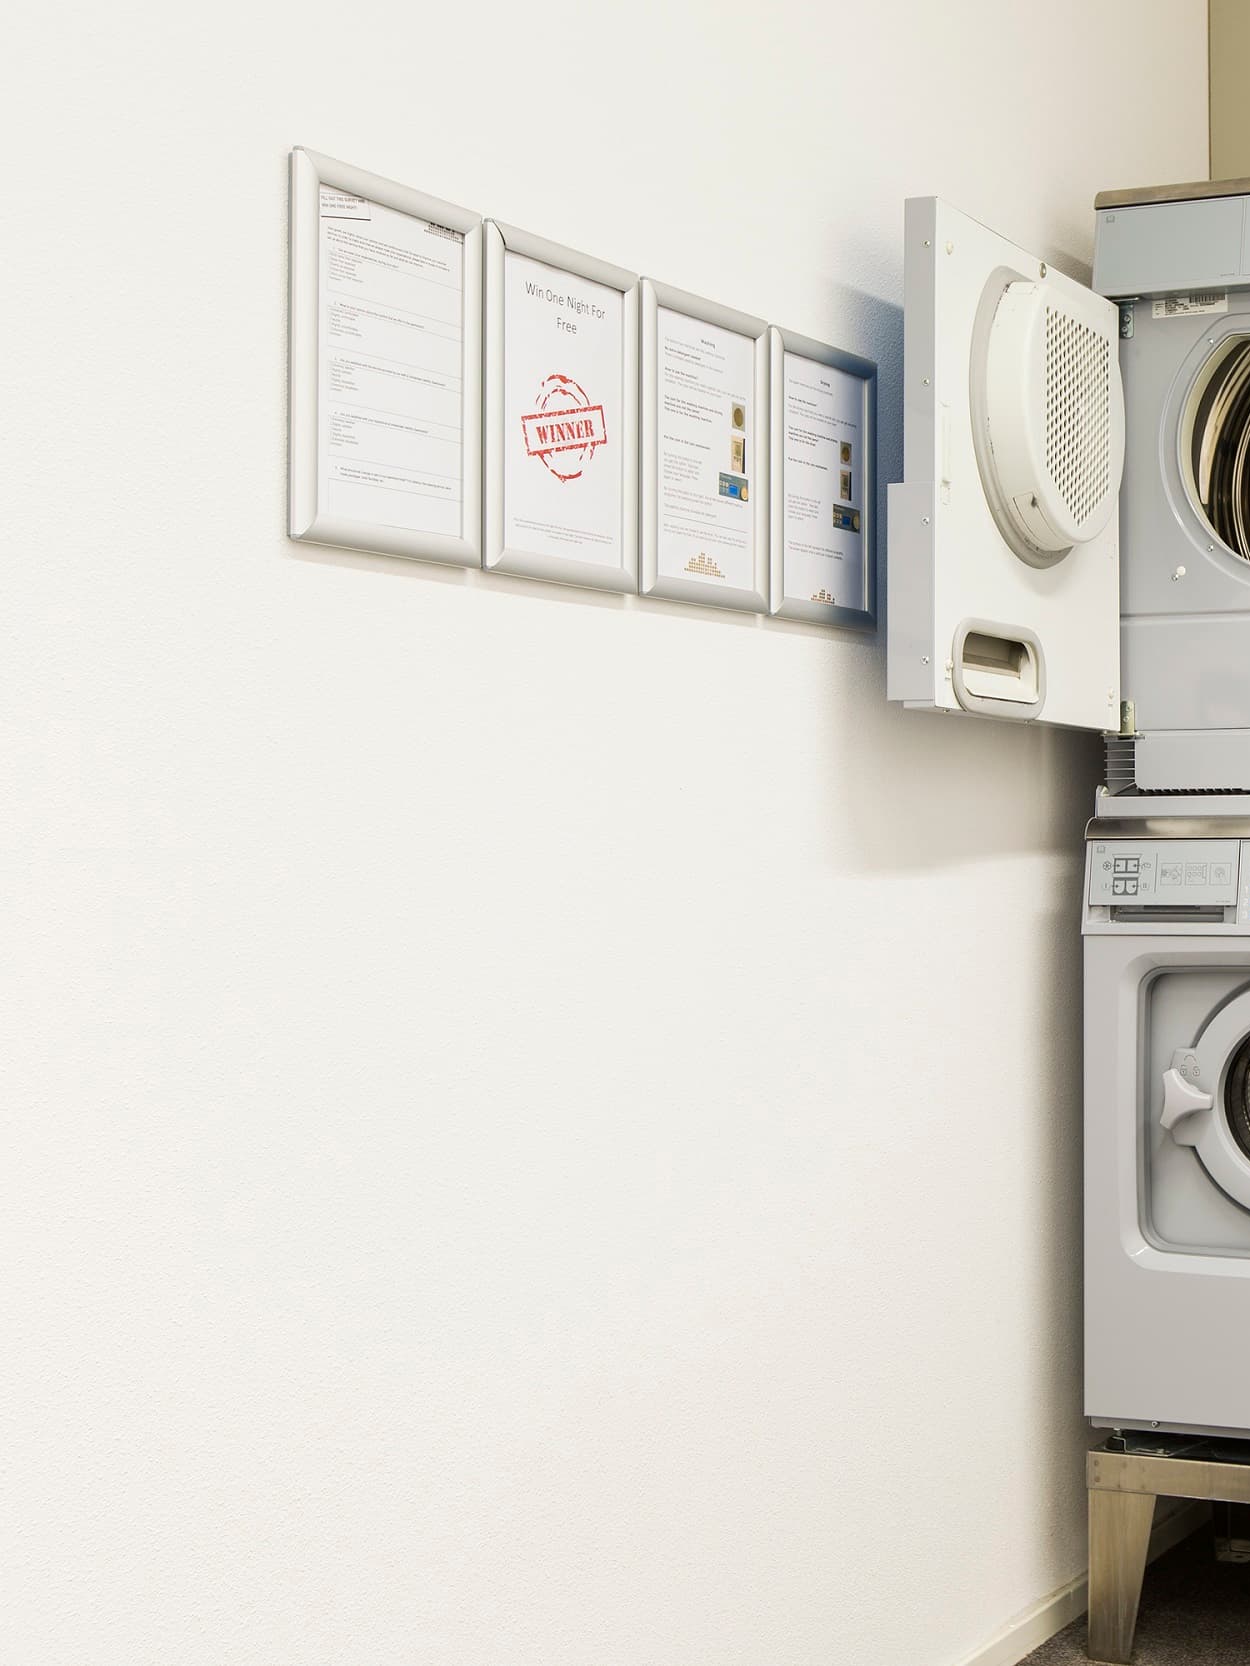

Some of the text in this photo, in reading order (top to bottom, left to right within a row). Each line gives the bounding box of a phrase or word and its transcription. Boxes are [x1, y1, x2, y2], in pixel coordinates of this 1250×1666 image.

[525, 280, 606, 319] Win One Night For
[556, 317, 577, 335] Free
[536, 419, 594, 445] WINNER
